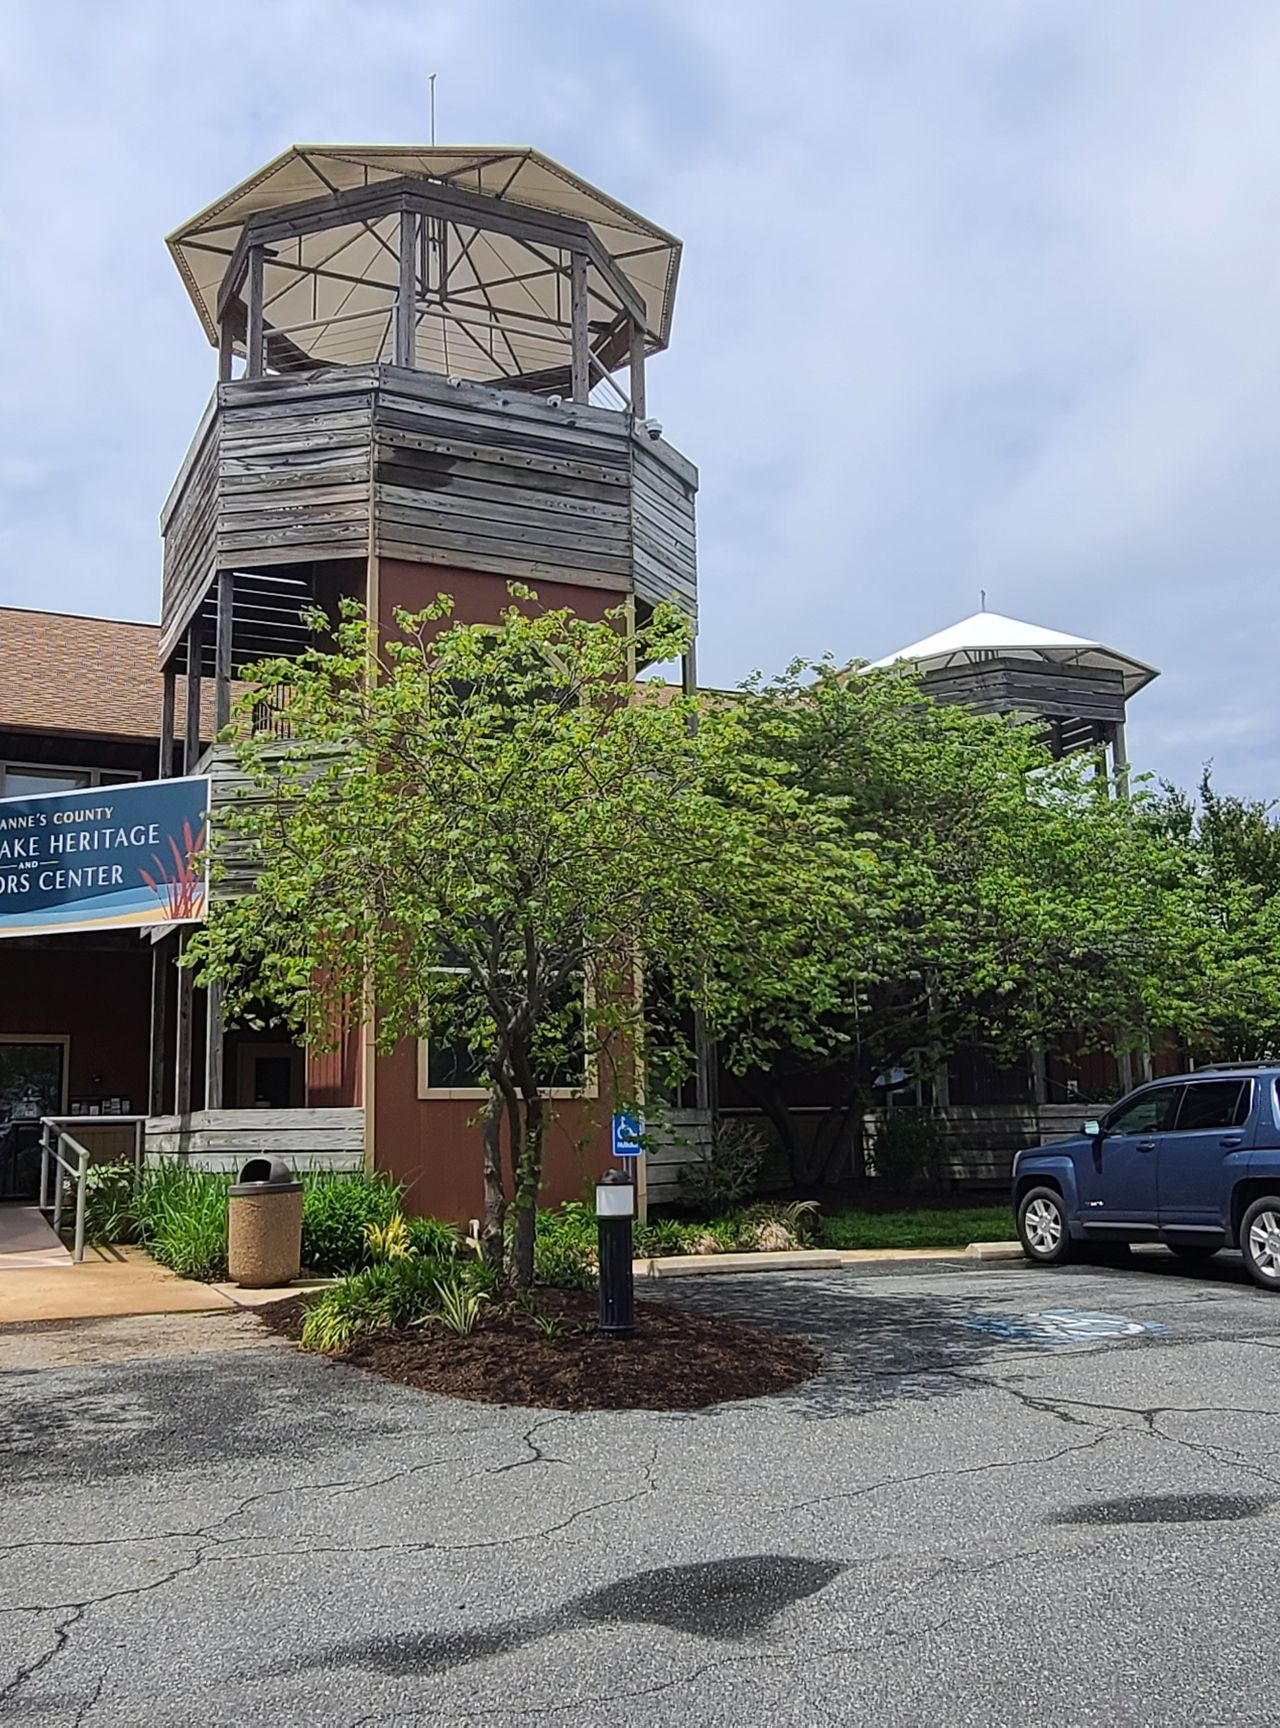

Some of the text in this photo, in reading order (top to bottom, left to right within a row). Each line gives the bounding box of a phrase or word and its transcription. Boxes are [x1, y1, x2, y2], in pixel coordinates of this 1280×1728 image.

[0, 813, 47, 830] ANNE'S
[53, 806, 114, 825] COUNTY
[49, 824, 160, 854] HERITAGE
[18, 860, 39, 870] AND
[38, 864, 124, 891] CENTER
